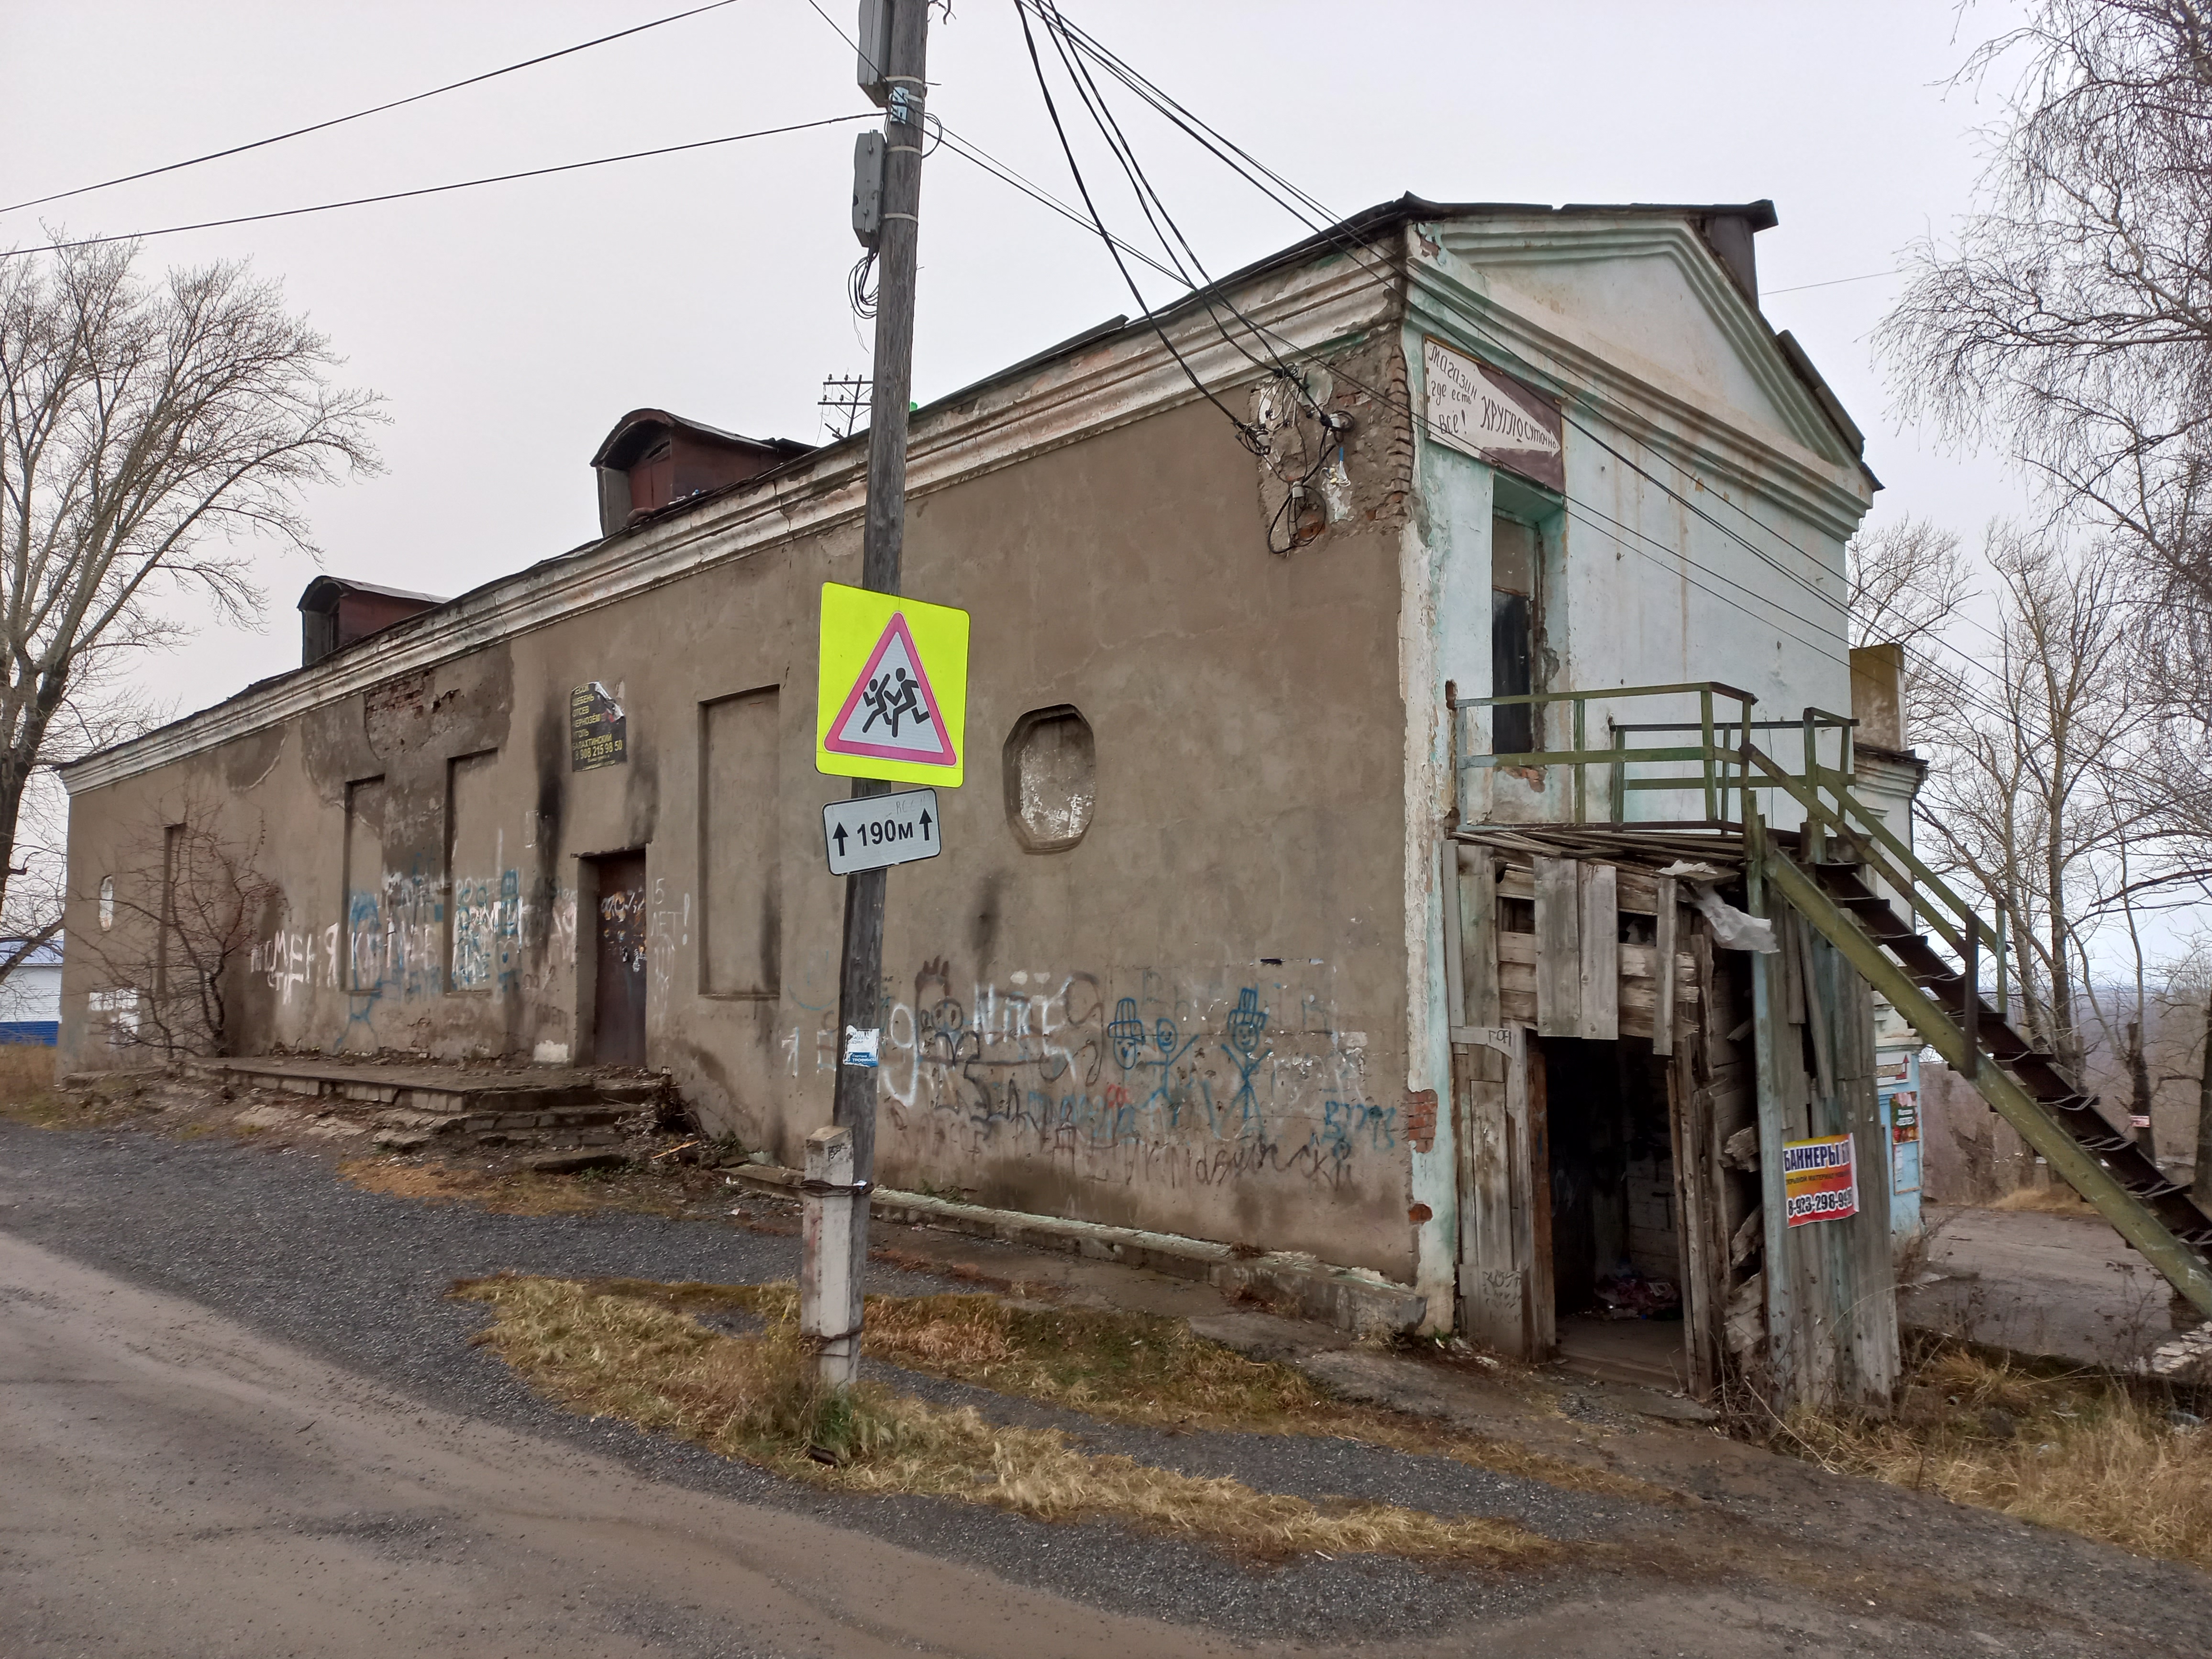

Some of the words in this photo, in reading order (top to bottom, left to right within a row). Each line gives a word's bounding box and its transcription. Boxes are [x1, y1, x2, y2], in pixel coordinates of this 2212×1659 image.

[593, 744, 604, 756] 215
[615, 740, 623, 752] 50
[1783, 1143, 1840, 1172] БАННЕРЫ
